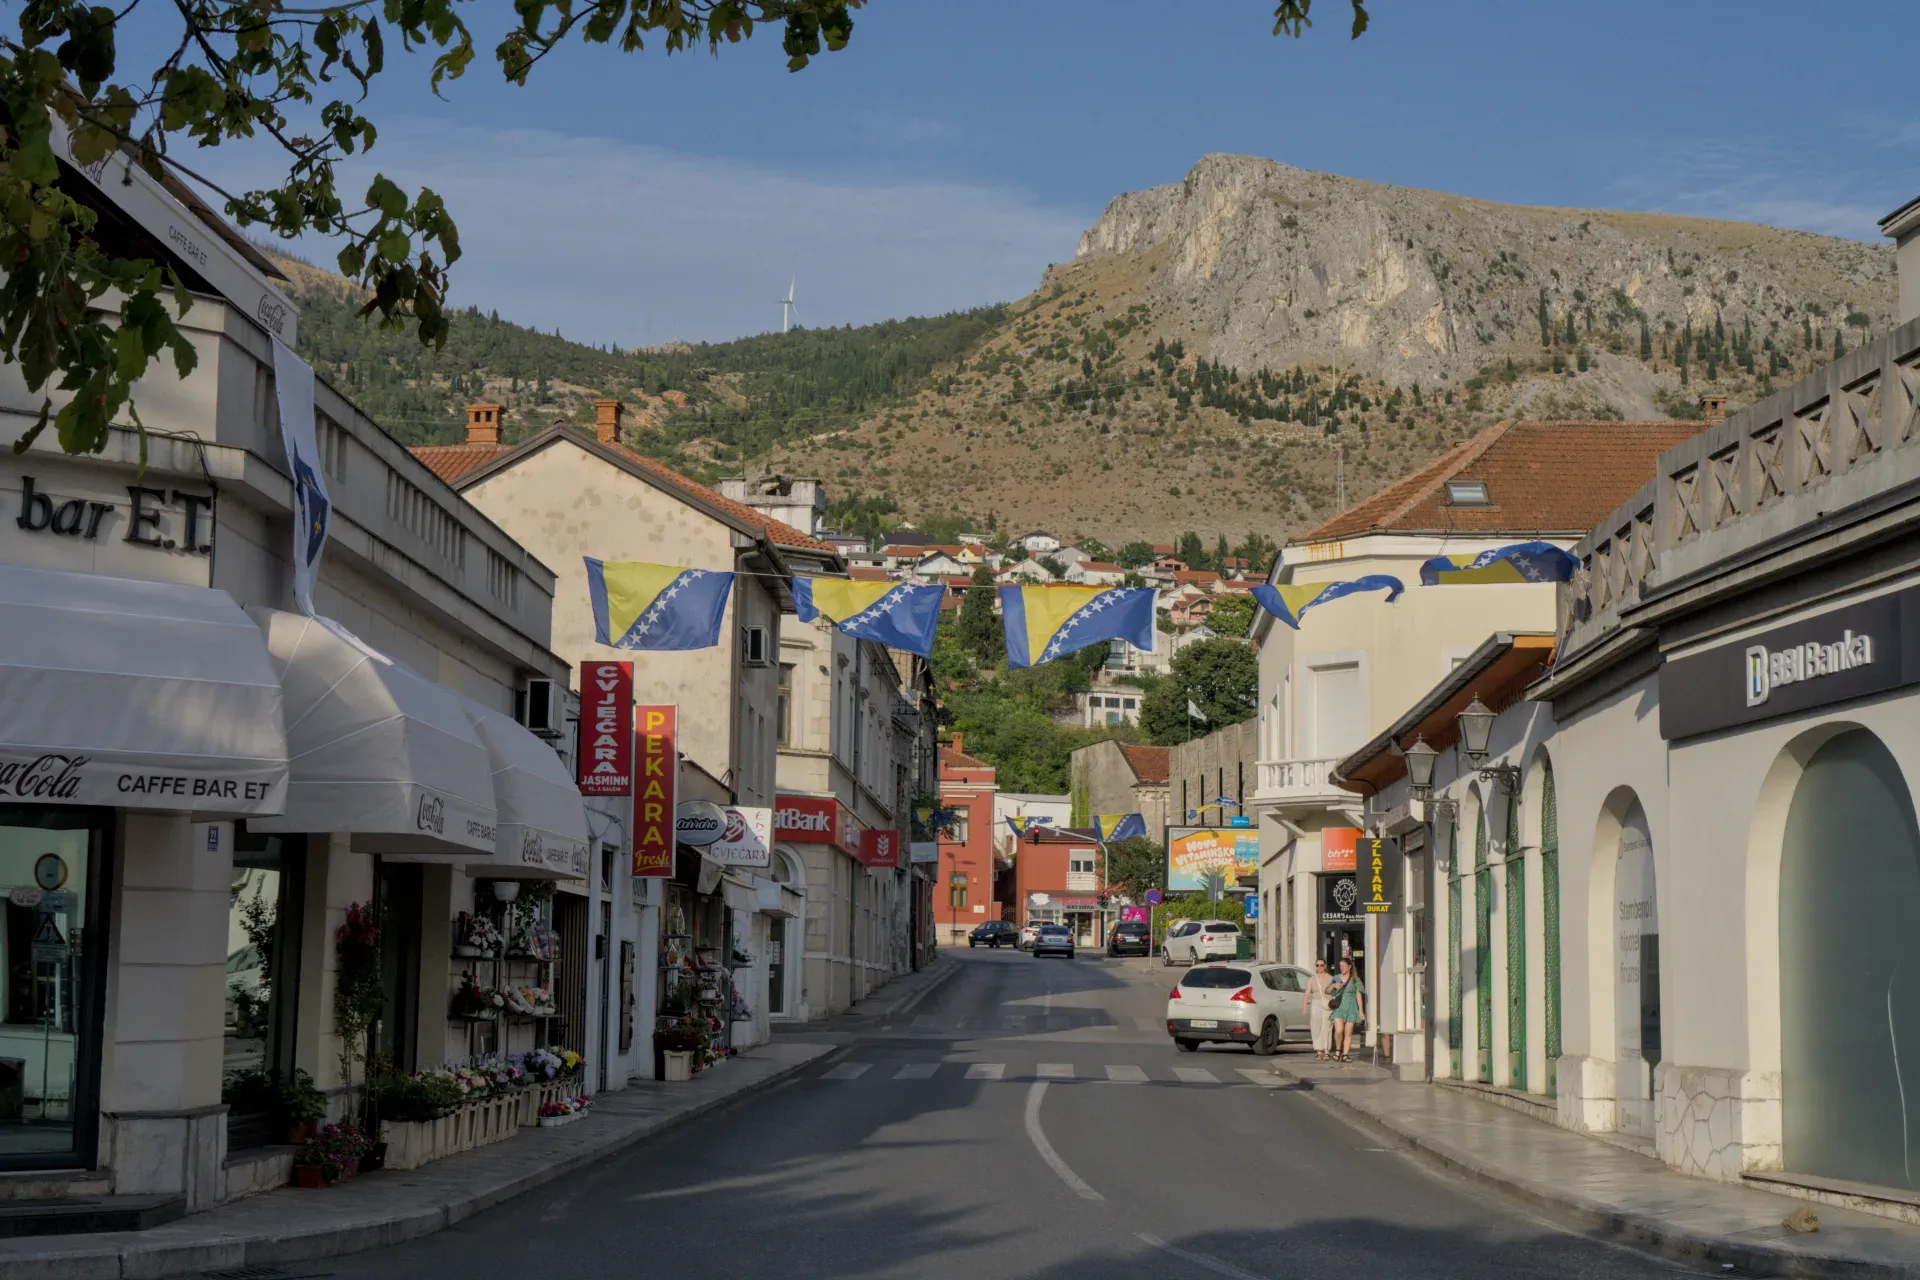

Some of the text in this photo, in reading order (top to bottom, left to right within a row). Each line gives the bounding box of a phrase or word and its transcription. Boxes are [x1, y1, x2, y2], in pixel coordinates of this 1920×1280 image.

[168, 225, 208, 268] CAFFE BAR ET
[16, 476, 114, 539] bar
[1770, 645, 1804, 688] BBI
[1805, 629, 1872, 679] Banka
[0, 754, 92, 798] a-Cola
[117, 774, 271, 800] CAFFE BAR ET
[581, 775, 629, 786] JASMINN
[642, 711, 665, 846] PEKARA
[466, 819, 481, 838] CAFFE
[480, 825, 491, 840] BAR
[635, 850, 671, 868] Fresh
[712, 846, 767, 861] CVJEĆARA
[1372, 840, 1383, 902] ZLATARA
